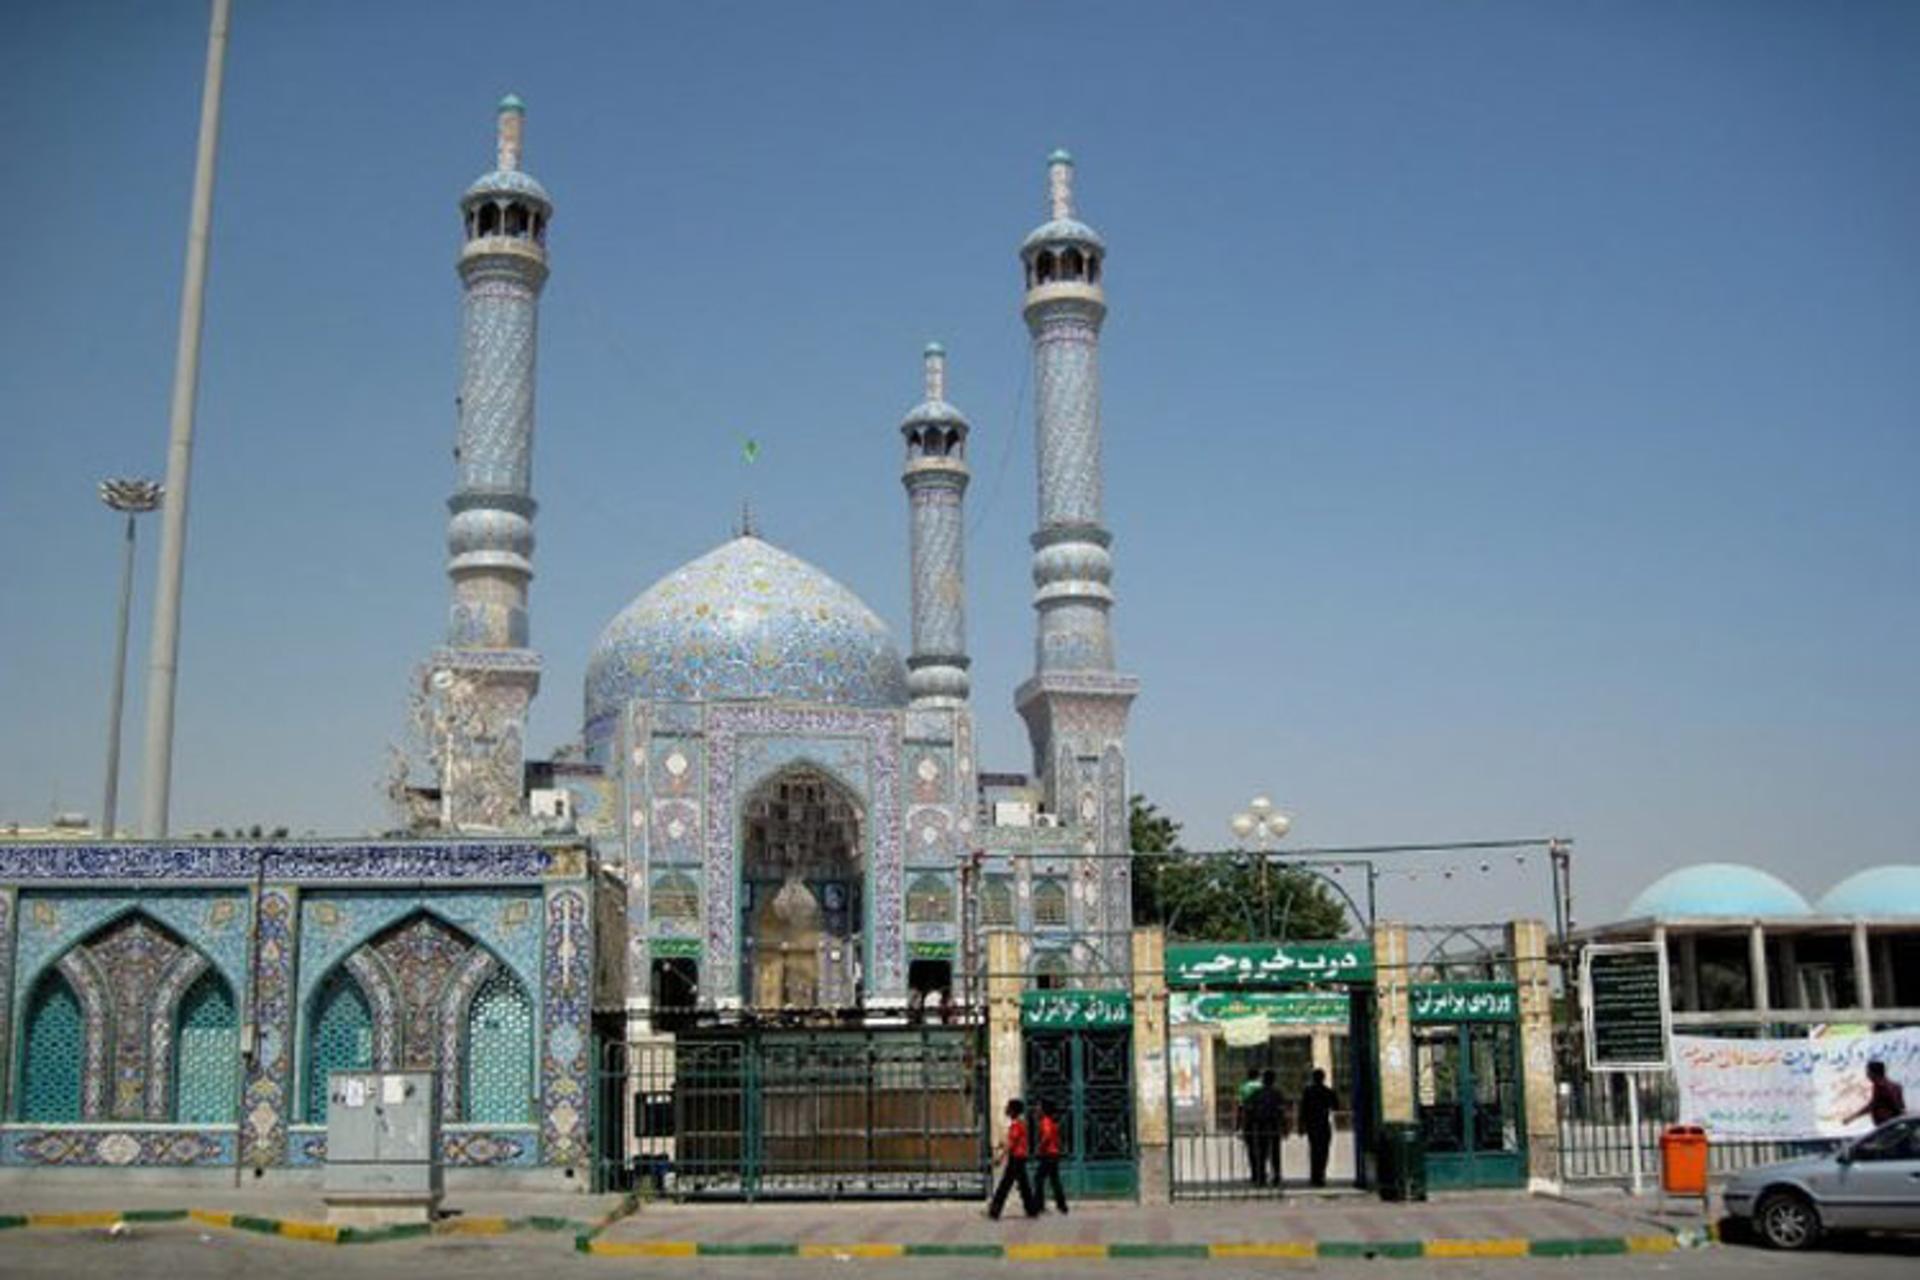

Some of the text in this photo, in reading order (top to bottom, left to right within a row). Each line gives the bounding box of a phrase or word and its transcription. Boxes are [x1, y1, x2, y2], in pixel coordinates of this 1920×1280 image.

[1178, 947, 1358, 984] درب خروجی
[1084, 998, 1127, 1023] ورودی
[1466, 992, 1512, 1015] ورودی
